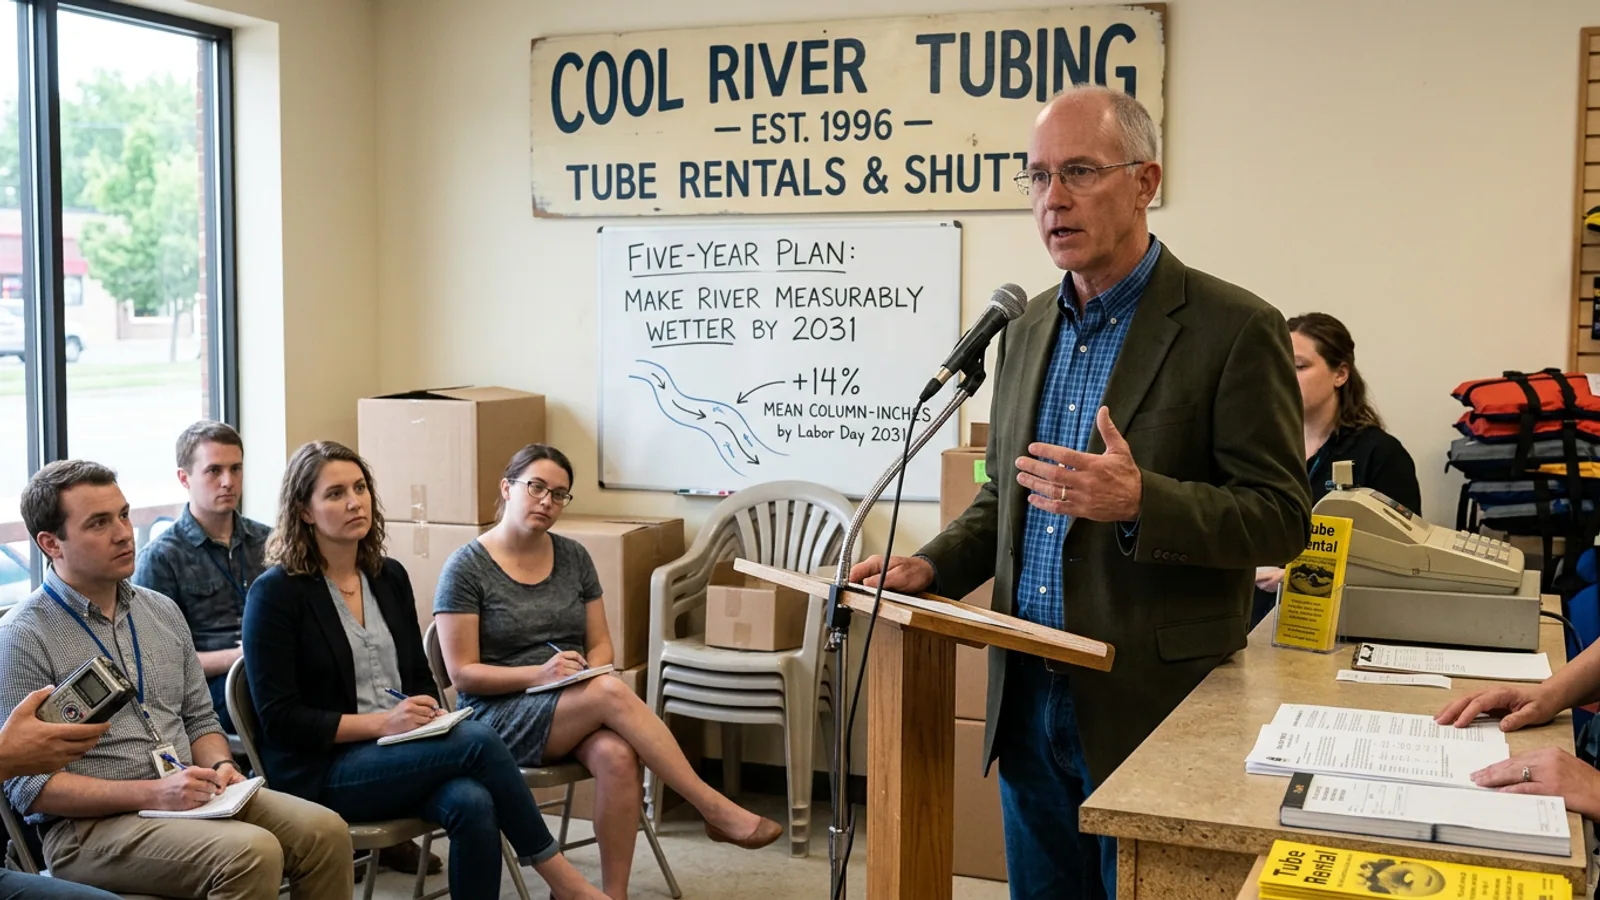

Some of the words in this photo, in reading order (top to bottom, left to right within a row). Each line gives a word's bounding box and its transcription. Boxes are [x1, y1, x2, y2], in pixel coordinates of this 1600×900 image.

[551, 48, 685, 134] COOL
[709, 37, 868, 104] RIVER
[915, 22, 1137, 103] TUBING
[752, 112, 810, 145] EST.
[820, 108, 893, 142] 1996
[565, 162, 658, 201] TUBE
[679, 156, 846, 199] RENTALS
[862, 155, 889, 195] &
[628, 240, 760, 271] FIVE-YEAR
[776, 239, 856, 266] PLAN:
[625, 288, 684, 312] MAKE
[698, 286, 761, 310] RIVER
[775, 285, 924, 313] MEASURABLY
[645, 317, 736, 341] WETTER
[752, 319, 778, 340] BY
[792, 316, 856, 342] 2031
[792, 366, 861, 396] +14%
[763, 402, 803, 417] MEAN
[808, 403, 932, 422] COLUMN-INCHES
[777, 424, 792, 443] by
[797, 423, 835, 439] Labor
[840, 425, 865, 447] Day
[871, 426, 906, 442] 2031
[1310, 522, 1335, 537] ube
[1305, 540, 1338, 553] ental
[1272, 850, 1306, 877] Tube
